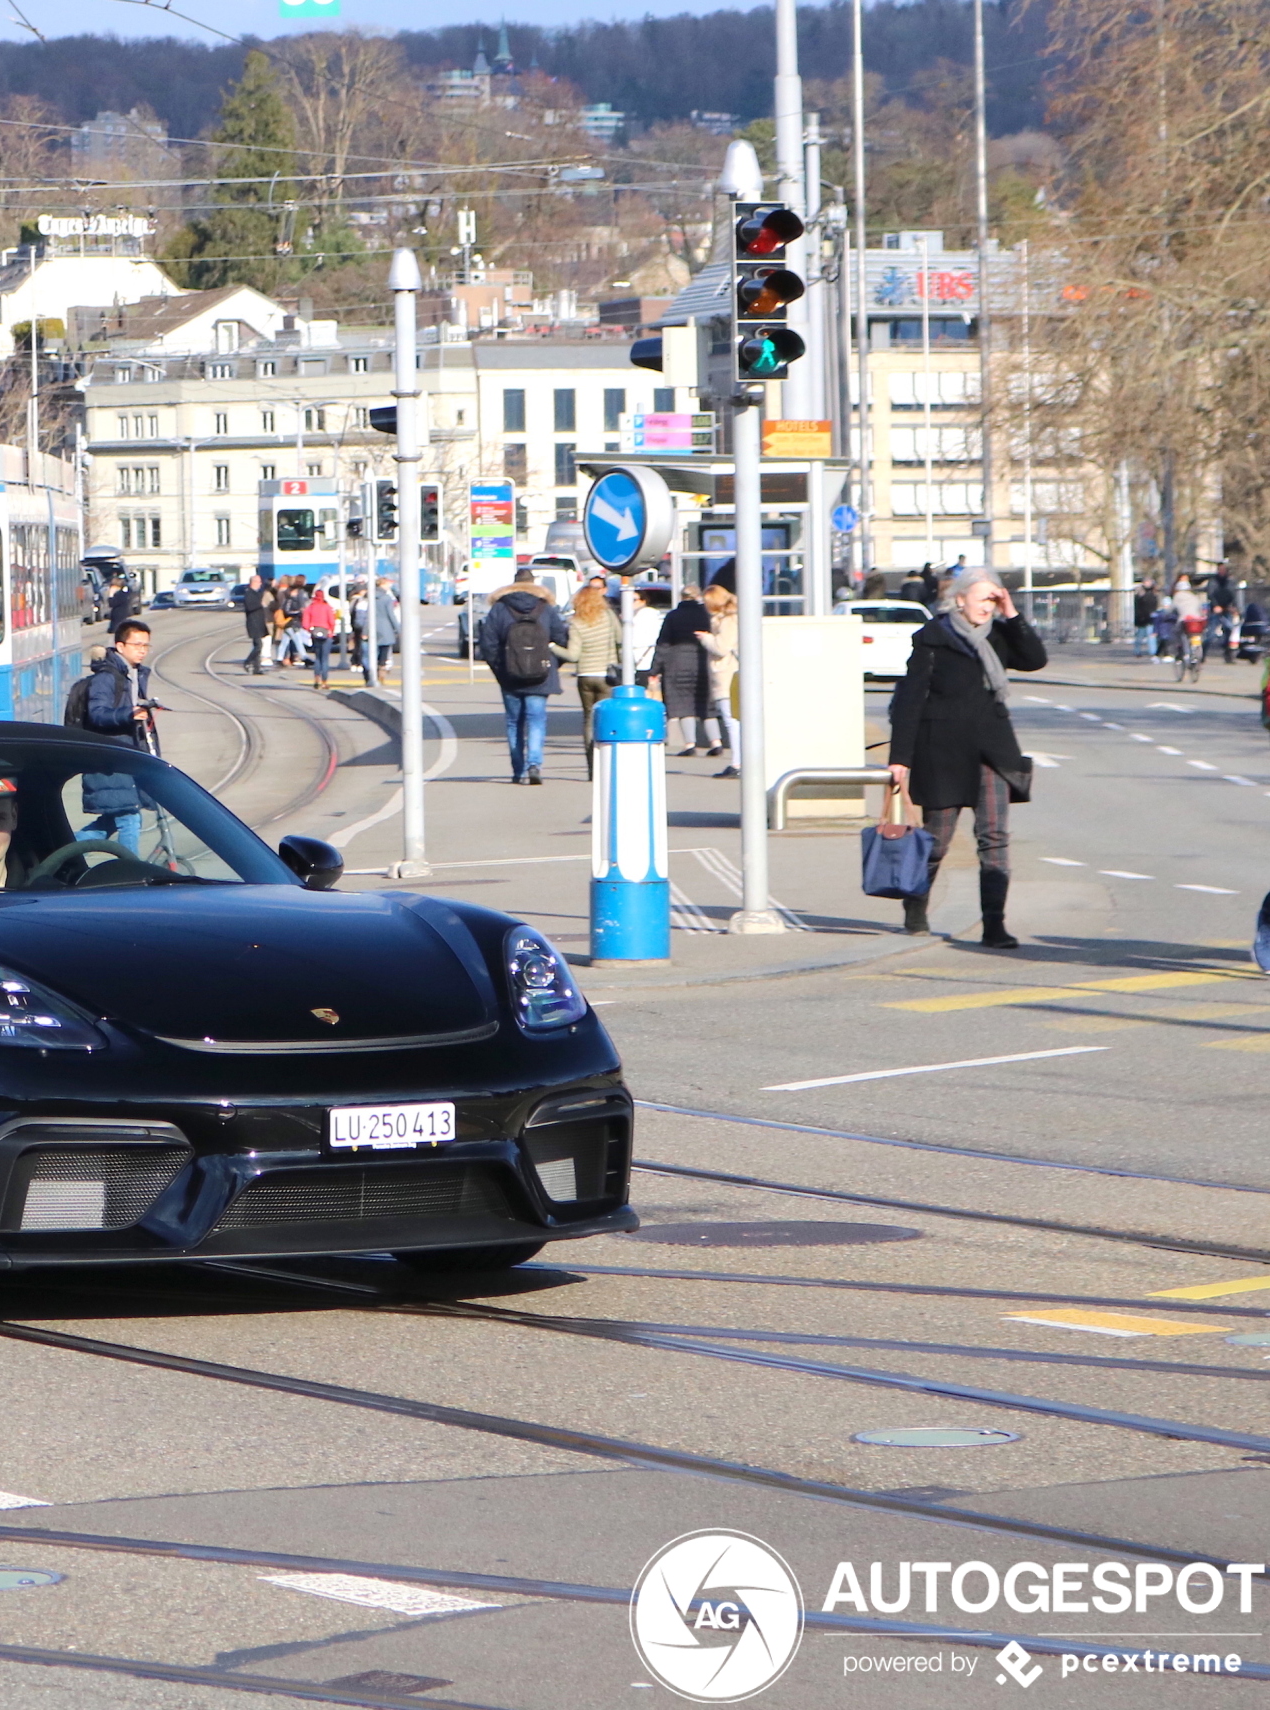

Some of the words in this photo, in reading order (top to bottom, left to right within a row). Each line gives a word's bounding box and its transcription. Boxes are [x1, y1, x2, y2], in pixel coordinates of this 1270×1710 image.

[917, 272, 974, 300] UBS
[775, 420, 819, 432] HOTELS
[290, 482, 301, 495] 2
